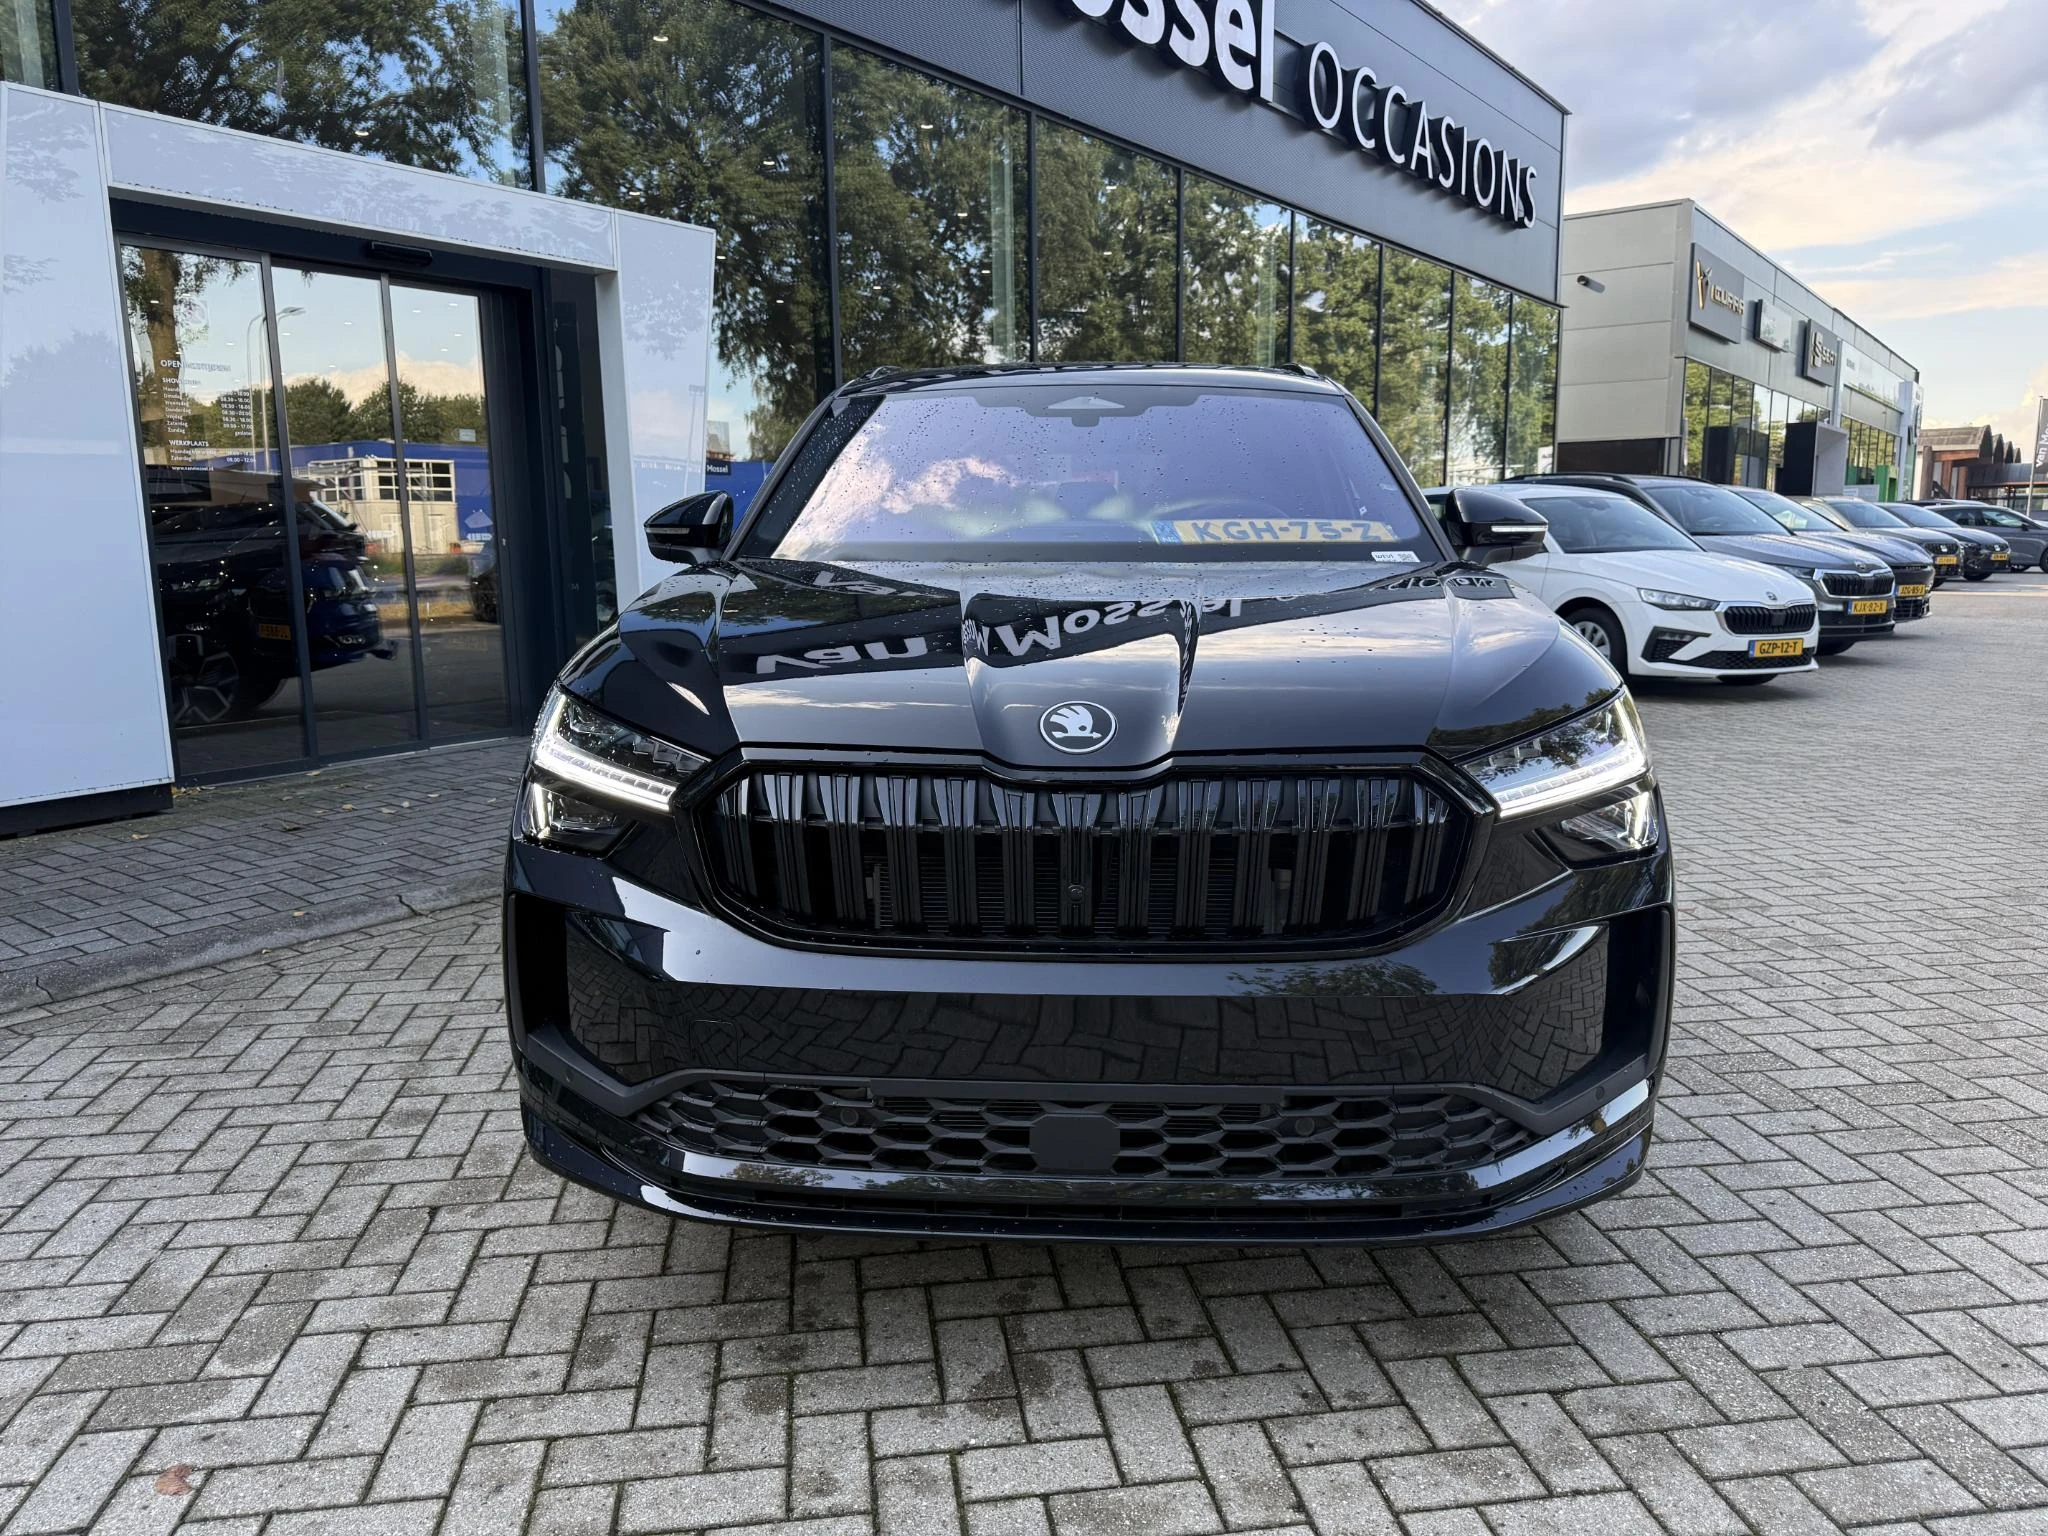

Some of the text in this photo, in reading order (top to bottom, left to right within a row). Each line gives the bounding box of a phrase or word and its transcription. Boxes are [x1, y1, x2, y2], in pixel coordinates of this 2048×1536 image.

[1070, 0, 1537, 228] sel OCCASIONS
[1759, 641, 1799, 655] GZP-12-T
